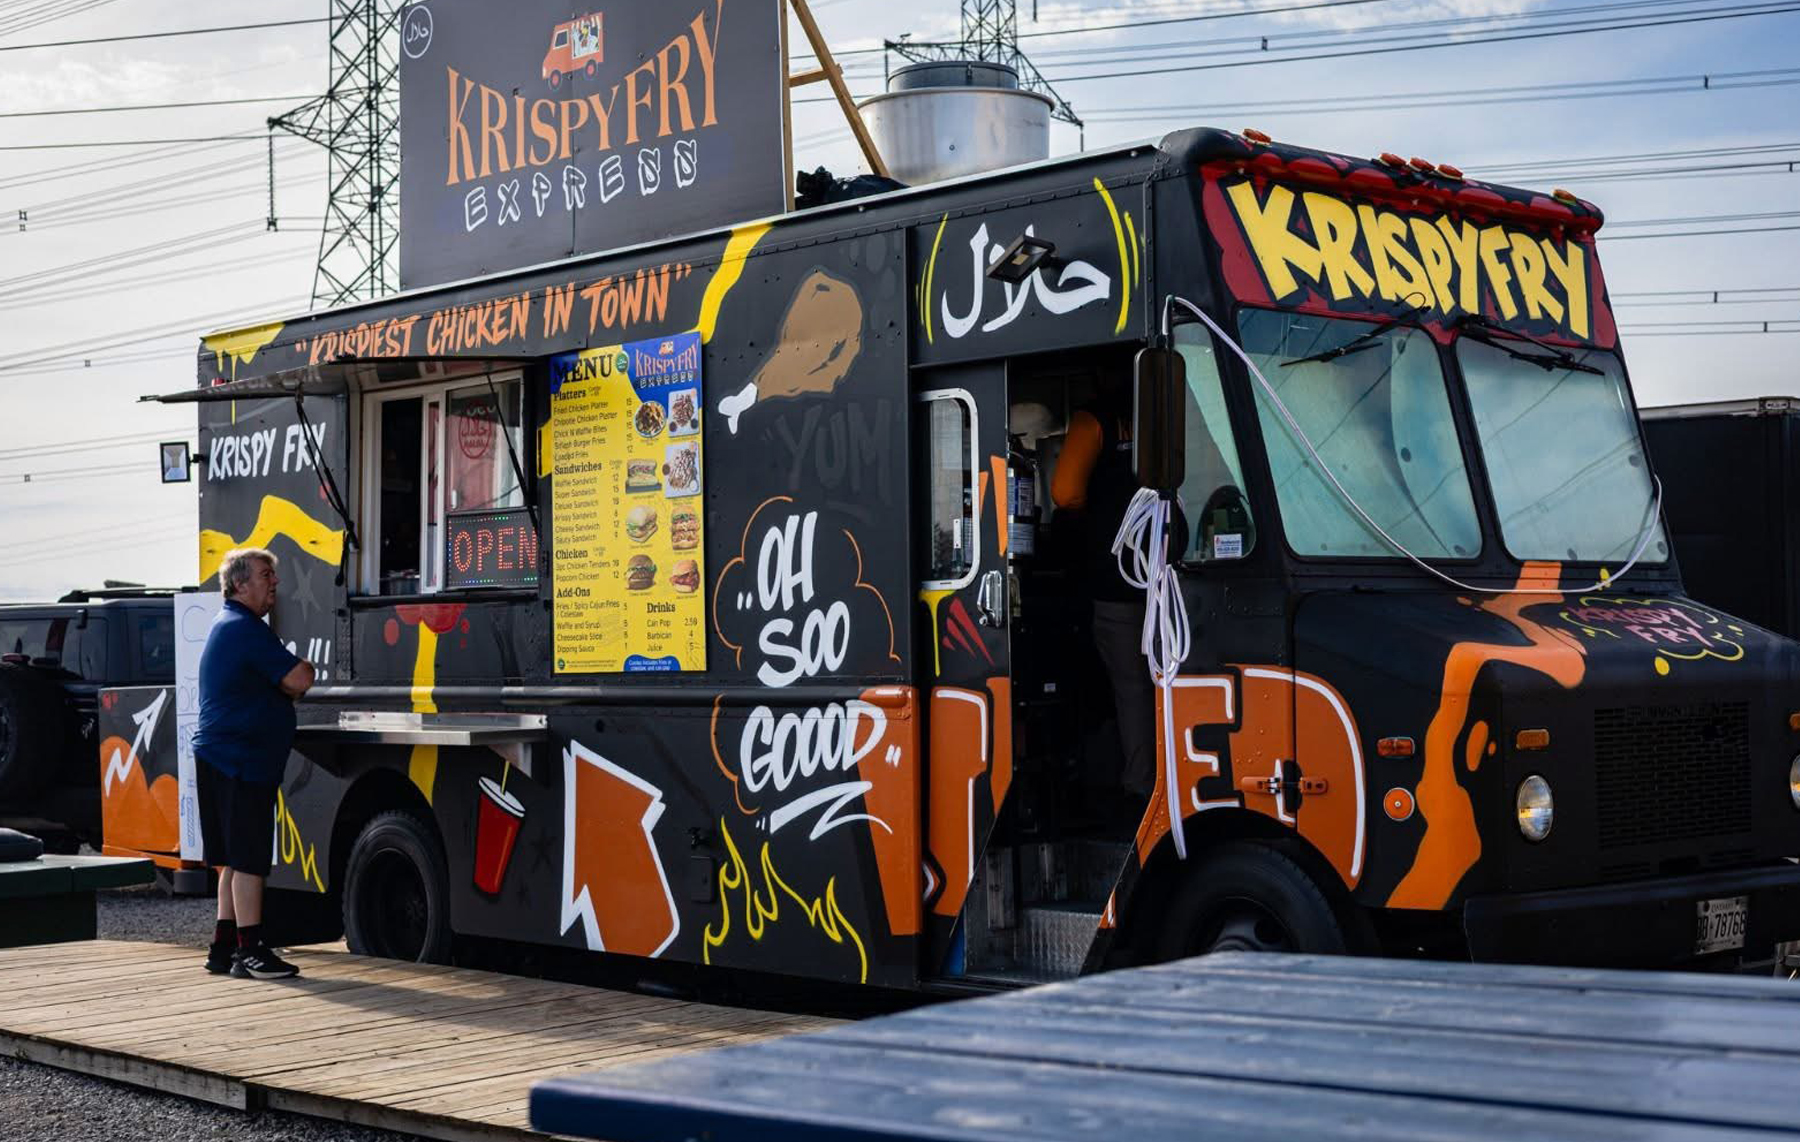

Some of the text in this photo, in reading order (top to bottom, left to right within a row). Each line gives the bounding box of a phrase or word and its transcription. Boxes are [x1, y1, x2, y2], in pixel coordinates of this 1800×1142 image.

[465, 139, 697, 232] EXPRESS
[427, 291, 530, 356] CHICKEN
[544, 281, 576, 338] IN
[553, 354, 613, 384] MENU
[554, 389, 587, 401] Platters
[568, 404, 590, 413] Chicken
[577, 413, 598, 423] Chicken
[208, 422, 326, 481] KRISPY FRY
[554, 461, 602, 475] Sandwiches
[454, 526, 537, 572] OPEN
[555, 549, 588, 560] Chicken
[556, 586, 591, 598] Add-Ons
[647, 602, 676, 613] Drinks
[757, 601, 850, 688] SOO
[1625, 624, 1714, 648] FRY
